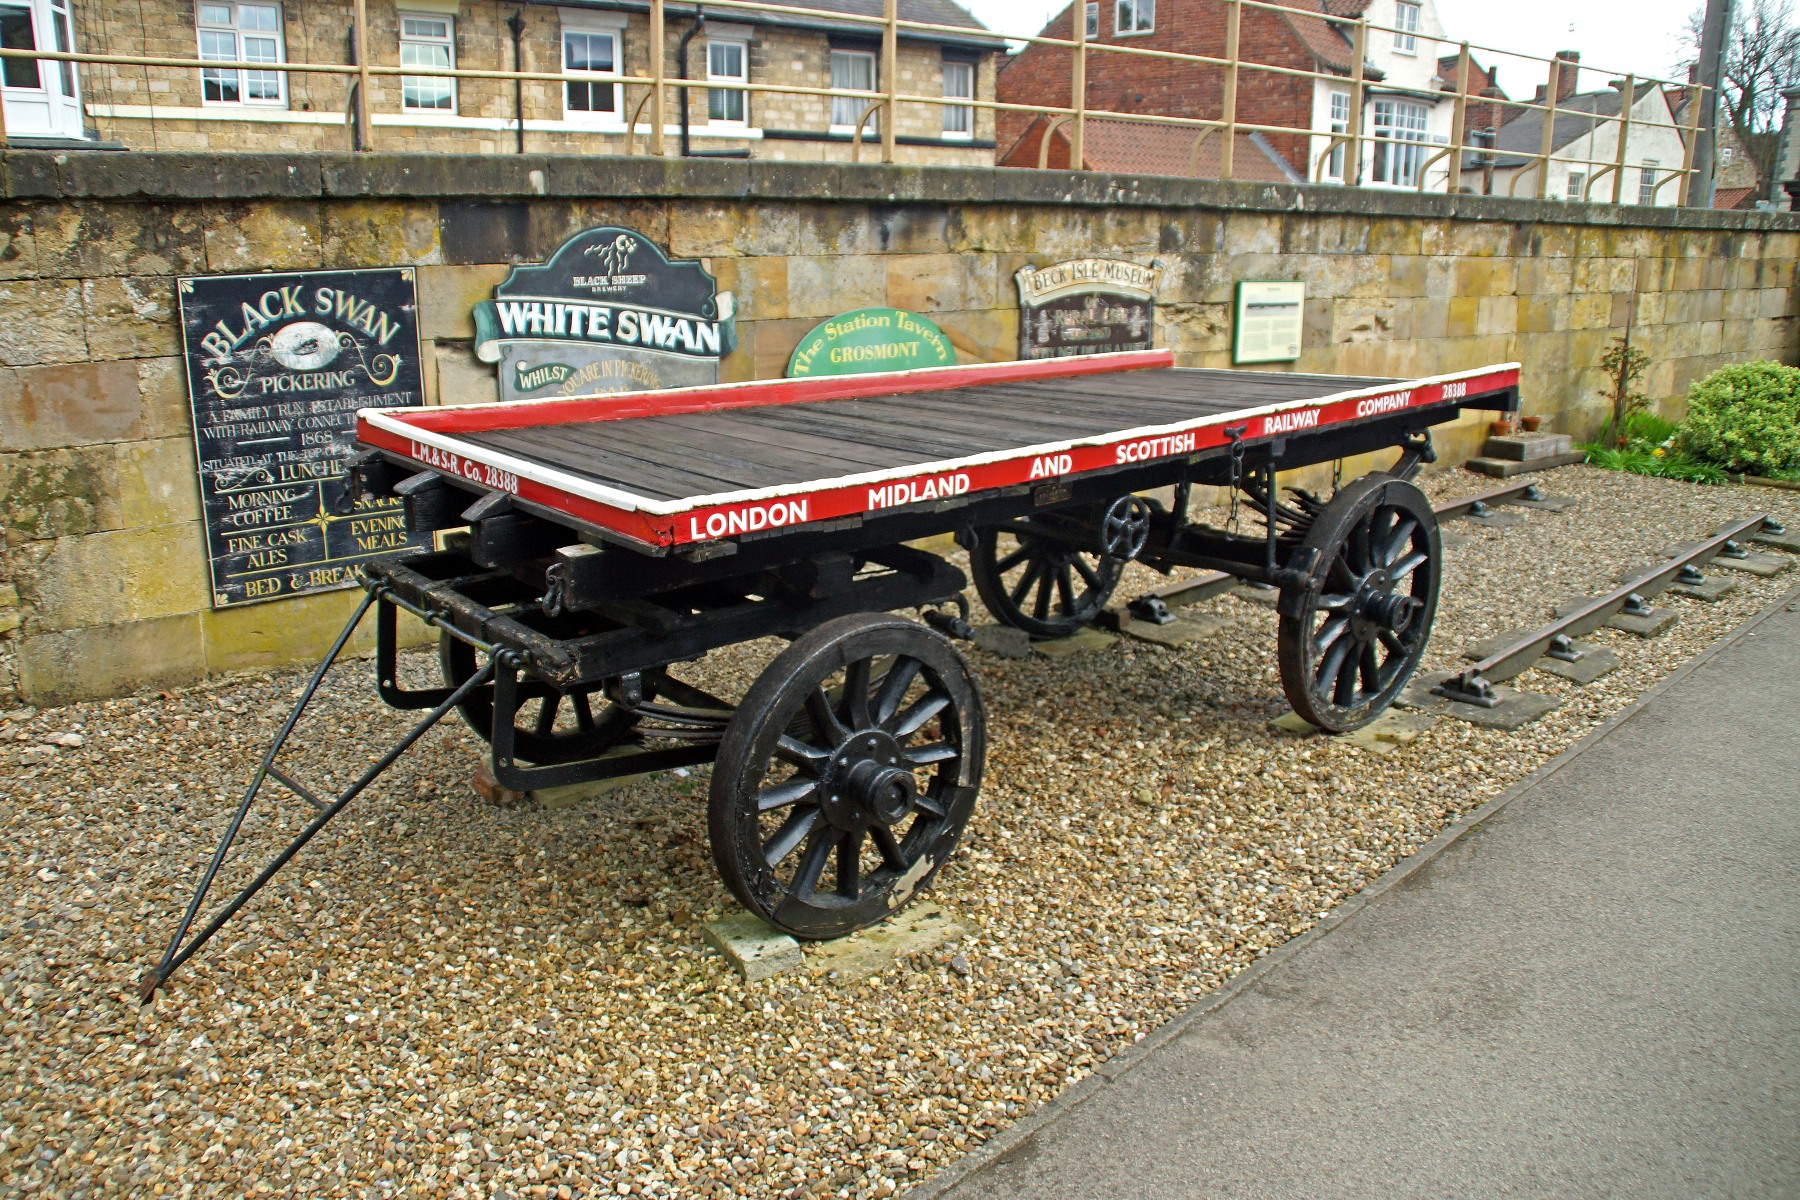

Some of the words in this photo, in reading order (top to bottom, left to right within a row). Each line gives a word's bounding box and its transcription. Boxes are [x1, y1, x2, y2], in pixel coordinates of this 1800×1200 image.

[572, 275, 608, 287] BLACK
[611, 274, 647, 286] SHEEP
[1033, 267, 1067, 290] BECK
[1072, 262, 1099, 280] ISLE
[1104, 262, 1155, 289] MUSEUM
[591, 285, 627, 293] BREWERY
[201, 285, 306, 358] BLACK
[314, 287, 400, 345] SWAN
[496, 302, 612, 340] WHITE
[615, 310, 720, 353] SWAN
[793, 338, 824, 376] The
[824, 312, 890, 341] Station
[895, 310, 948, 361] Tavern
[829, 341, 920, 363] GROSMONT
[260, 370, 355, 394] PICKERING
[518, 365, 569, 389] WHILST
[557, 374, 580, 396] YOU
[580, 362, 600, 385] ARE
[601, 360, 612, 377] IN
[615, 360, 660, 390] PICKERING
[277, 401, 305, 417] RUN
[311, 391, 412, 414] ESTABLISHMENT
[203, 424, 236, 440] WITH
[241, 418, 293, 436] RAILWAY
[297, 412, 358, 429] CONNECTI
[301, 430, 333, 446] 1868
[276, 450, 297, 462] THE
[690, 499, 808, 541] LONDON
[868, 473, 970, 510] MIDLAND
[1030, 454, 1073, 479] AND
[1116, 432, 1196, 465] SCOTTISH
[1264, 409, 1321, 435] RAILWAY
[1356, 391, 1412, 417] COMPANY
[1441, 382, 1467, 400] 28388
[463, 460, 482, 482] Co.
[484, 465, 518, 495] 28388
[227, 488, 296, 510] MORNING
[232, 505, 293, 527] COFFEE
[228, 535, 260, 553] FINE
[267, 528, 309, 547] CASK
[356, 531, 408, 551] MEALS
[247, 548, 287, 569] ALES
[245, 577, 281, 598] BED
[290, 573, 304, 590] &
